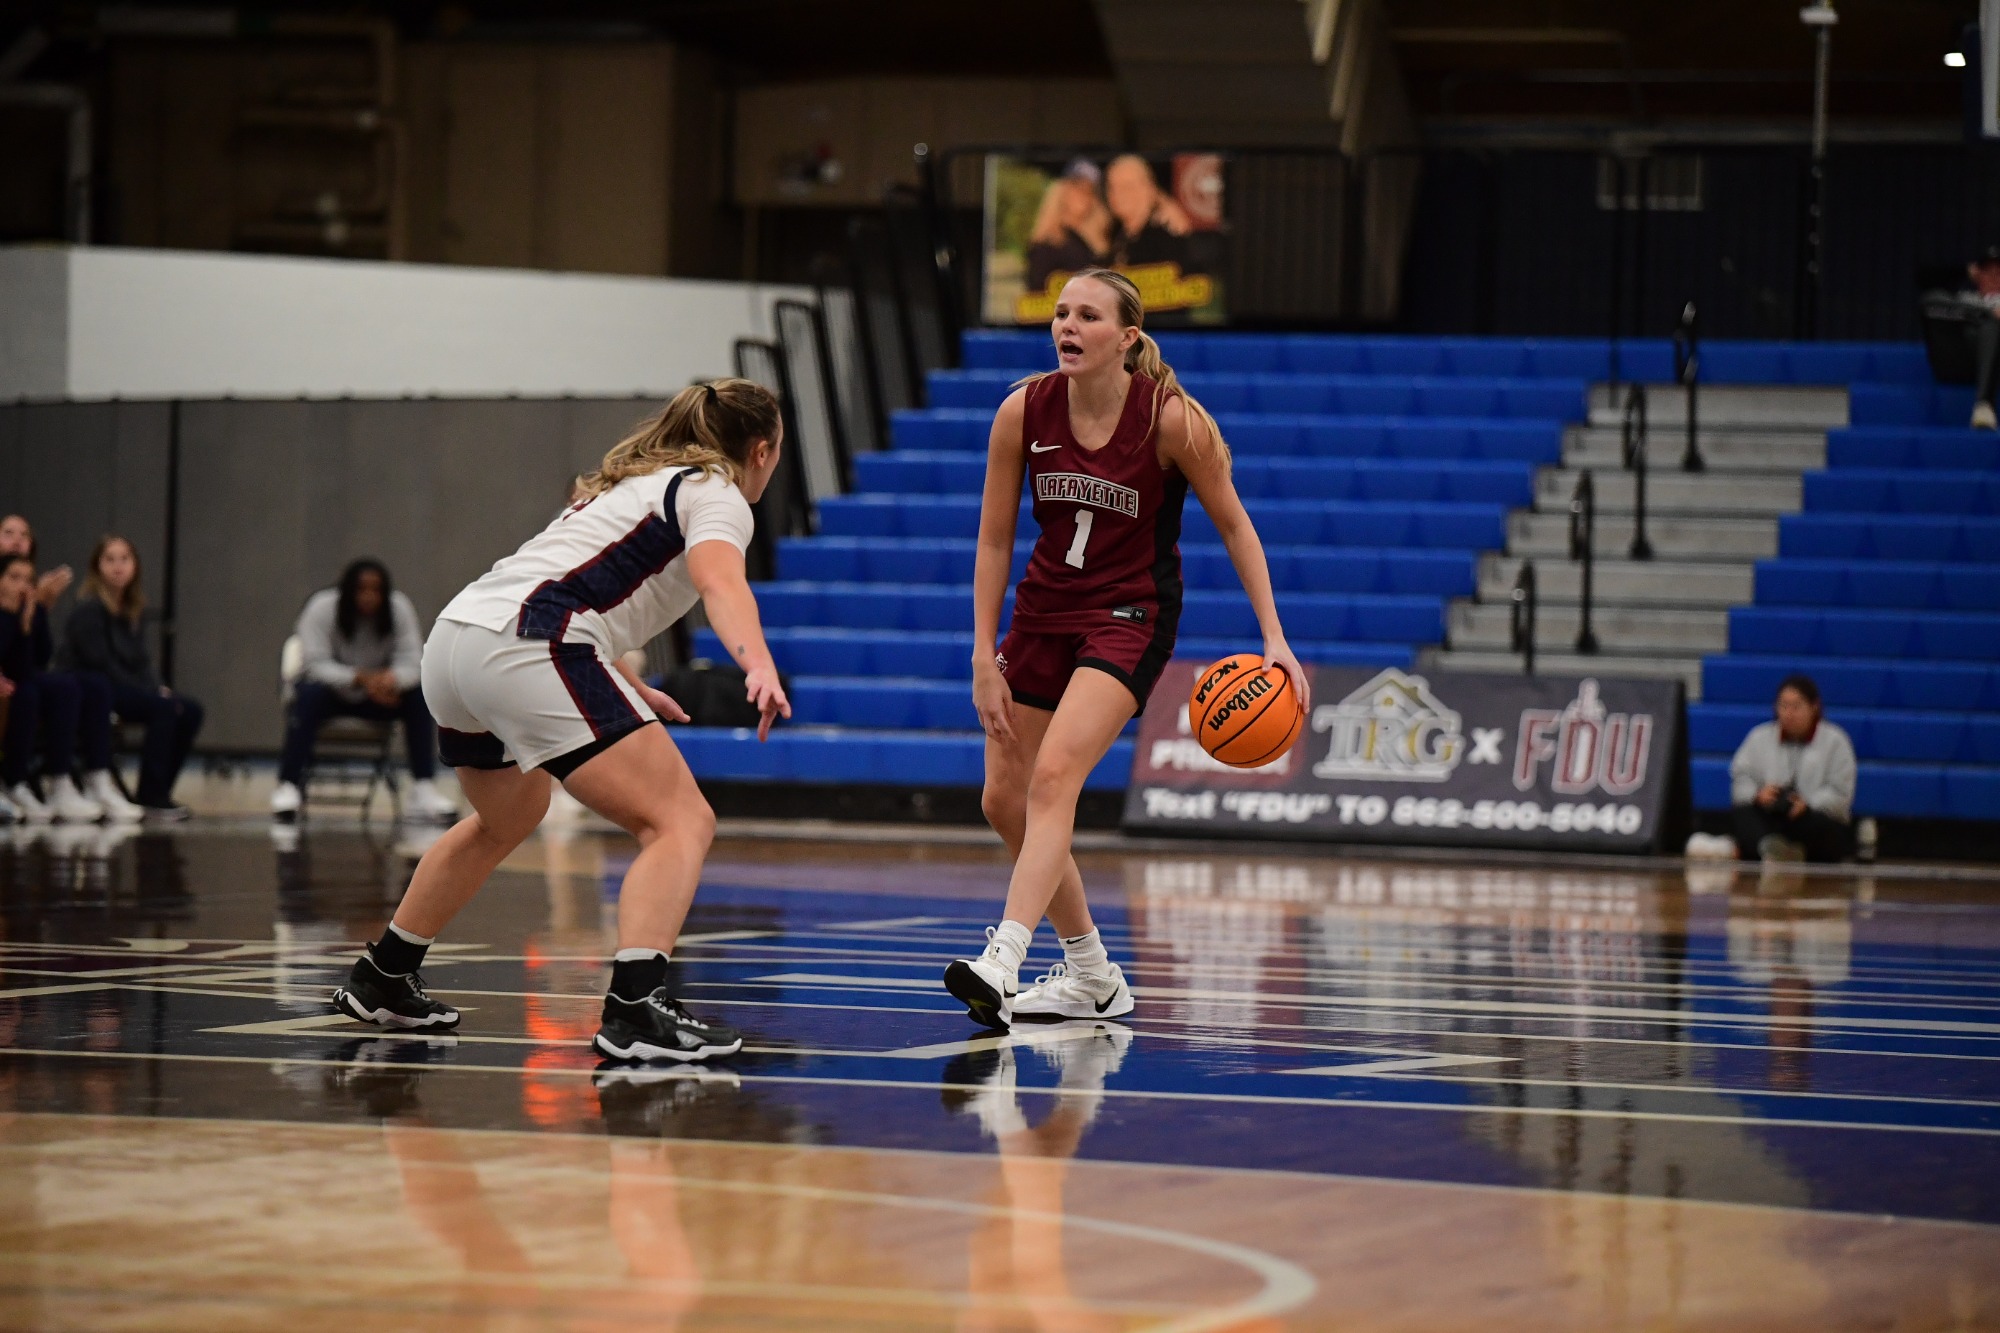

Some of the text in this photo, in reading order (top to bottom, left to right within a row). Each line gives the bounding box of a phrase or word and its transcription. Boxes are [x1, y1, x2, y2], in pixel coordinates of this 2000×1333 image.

[1038, 475, 1136, 515] LAFAYETTE
[1065, 508, 1093, 569] 1
[1135, 610, 1143, 619] M
[1195, 660, 1239, 705] NCAA
[1207, 675, 1273, 731] Wilson
[1512, 703, 1654, 796] FDU
[1142, 787, 1218, 820] Text
[1336, 794, 1389, 826] TO
